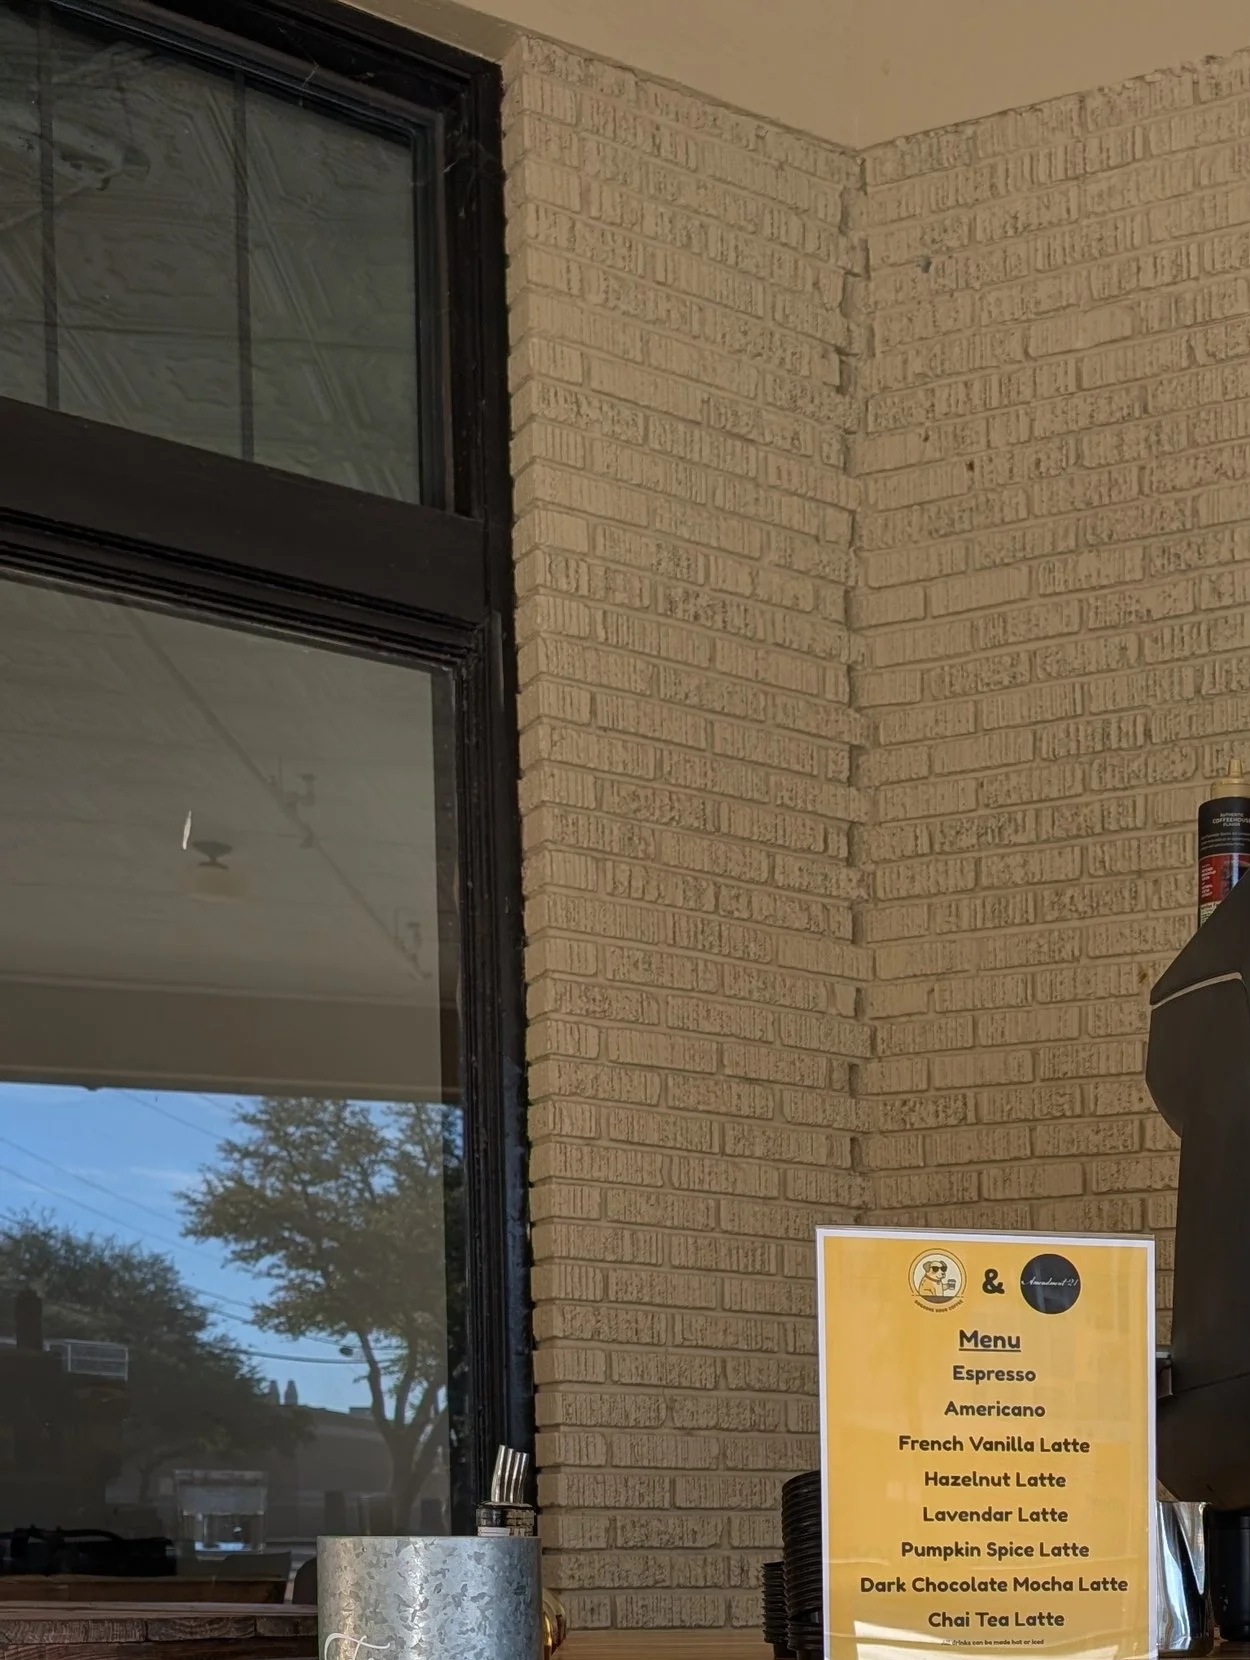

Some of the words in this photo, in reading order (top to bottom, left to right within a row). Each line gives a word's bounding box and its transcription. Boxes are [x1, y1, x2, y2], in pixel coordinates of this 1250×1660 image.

[982, 1268, 1005, 1294] &
[1021, 1275, 1066, 1287] Amendment
[959, 1330, 1021, 1351] Menu
[953, 1365, 1036, 1384] Espresso
[944, 1400, 1046, 1418] Americano
[899, 1435, 964, 1452] French
[969, 1436, 1035, 1453] Vanilla
[1040, 1437, 1090, 1453] Latte
[924, 1471, 1011, 1487] Hazelnut
[1016, 1472, 1067, 1488] Latte
[923, 1507, 1013, 1523] Lavendar
[1018, 1507, 1069, 1523] Latte
[901, 1541, 981, 1562] Pumpkin
[986, 1541, 1035, 1562] Spice
[1039, 1542, 1090, 1558] Latte
[860, 1576, 907, 1593] Dark
[911, 1576, 1008, 1593] Chocolate
[1013, 1576, 1074, 1592] Mocha
[1078, 1576, 1129, 1592] Latte
[928, 1611, 970, 1628] Chai
[974, 1612, 1010, 1628] Tea
[1014, 1611, 1065, 1627] Latte
